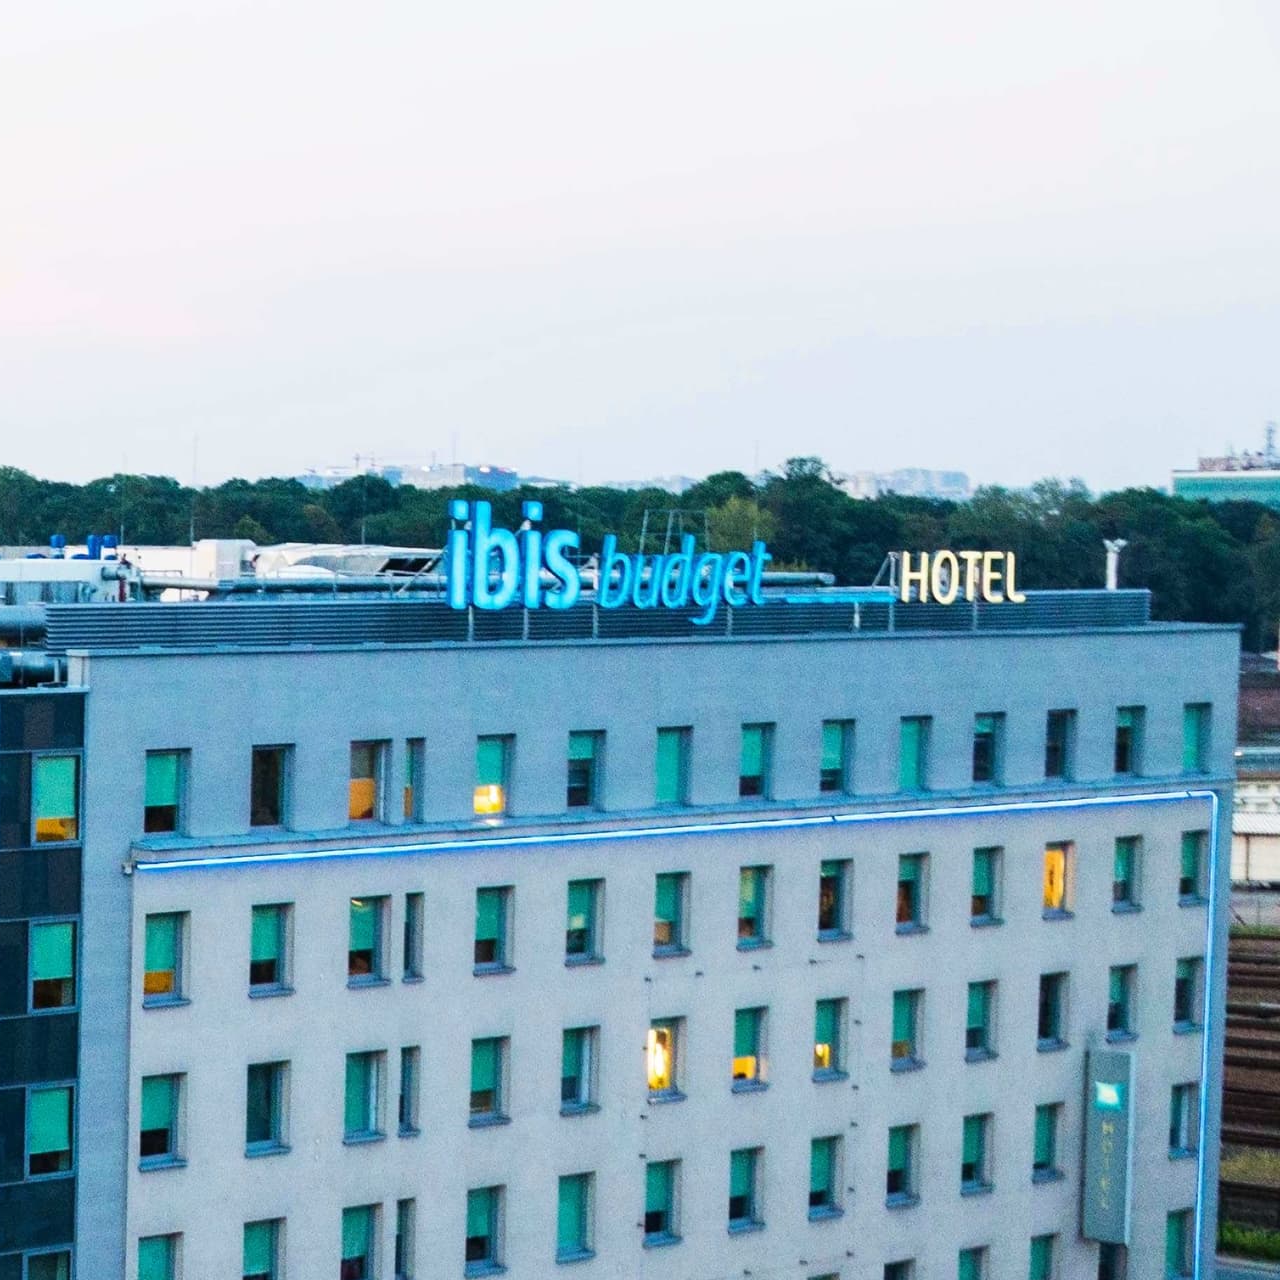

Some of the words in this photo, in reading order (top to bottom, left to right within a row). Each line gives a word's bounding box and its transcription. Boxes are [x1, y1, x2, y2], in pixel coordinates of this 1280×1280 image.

[447, 499, 581, 610] ibis
[598, 532, 773, 625] budget
[901, 549, 1026, 605] HOTEL
